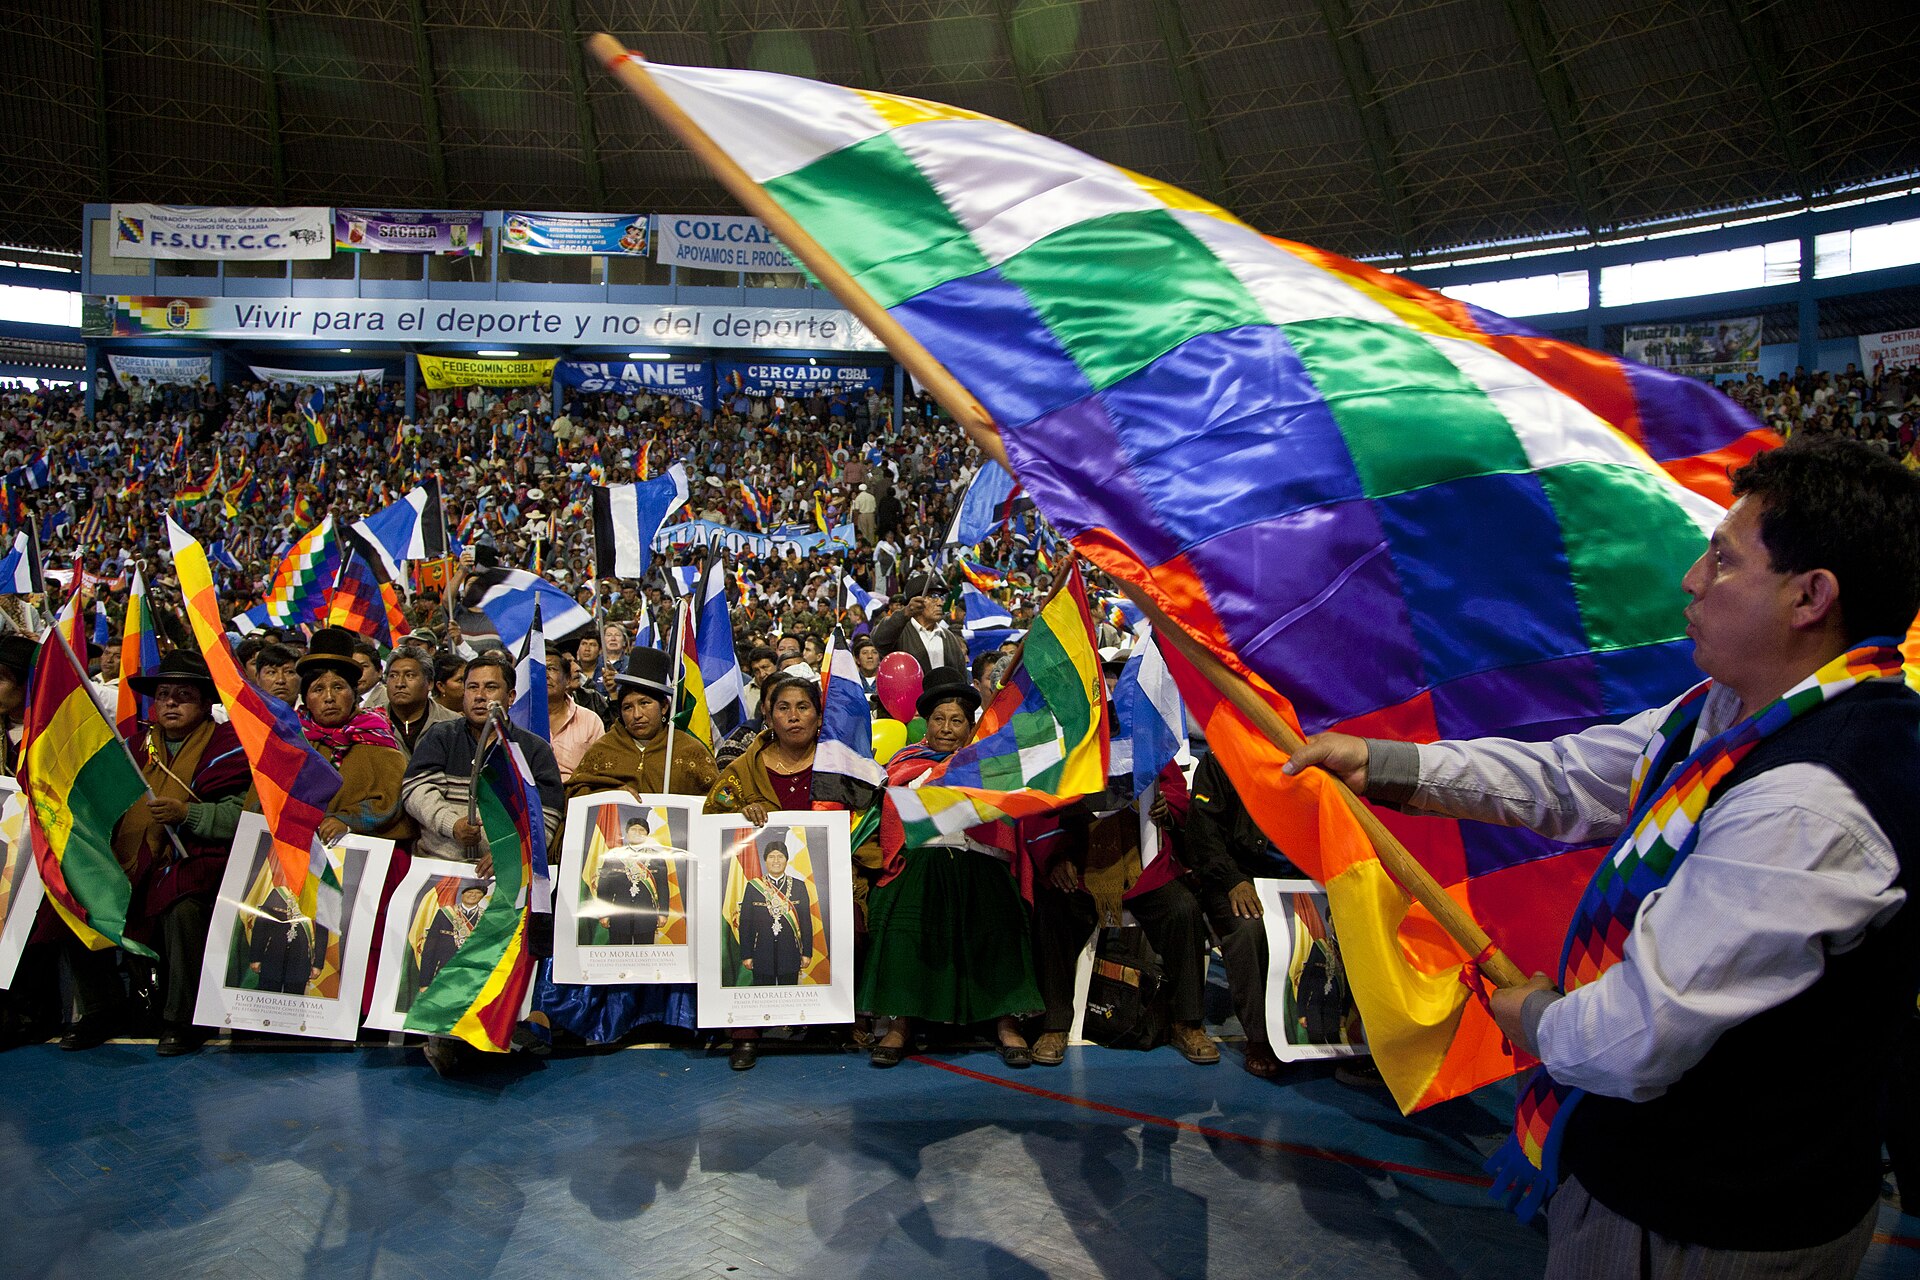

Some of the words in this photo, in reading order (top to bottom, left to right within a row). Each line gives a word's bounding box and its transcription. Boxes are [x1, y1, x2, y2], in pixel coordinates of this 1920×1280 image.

[378, 225, 438, 239] SACABA
[150, 231, 288, 250] F.S.U.T.C.C.
[676, 244, 734, 264] APOYAMOS
[736, 250, 750, 265] EL
[234, 304, 302, 328] Vivir
[312, 309, 385, 335] para
[397, 307, 425, 331] el
[436, 308, 562, 338] deporte
[573, 314, 592, 338] y
[602, 314, 641, 335] no
[653, 312, 702, 336] del
[713, 312, 838, 343] deporte
[113, 356, 170, 367] COOPERATIVA
[442, 360, 538, 373] FEDECOMIN-CBBA.
[566, 361, 702, 385] "PLANE"
[748, 366, 832, 380] CERCADO
[837, 368, 871, 380] CBBA.
[456, 376, 528, 385] COCHABAMBA
[581, 378, 616, 391] SI
[696, 386, 704, 394] Y
[745, 386, 767, 397] Con
[235, 994, 254, 1002] EVO
[256, 996, 297, 1007] MORALES
[299, 1001, 324, 1010] AYMA
[734, 992, 751, 1000] EVO
